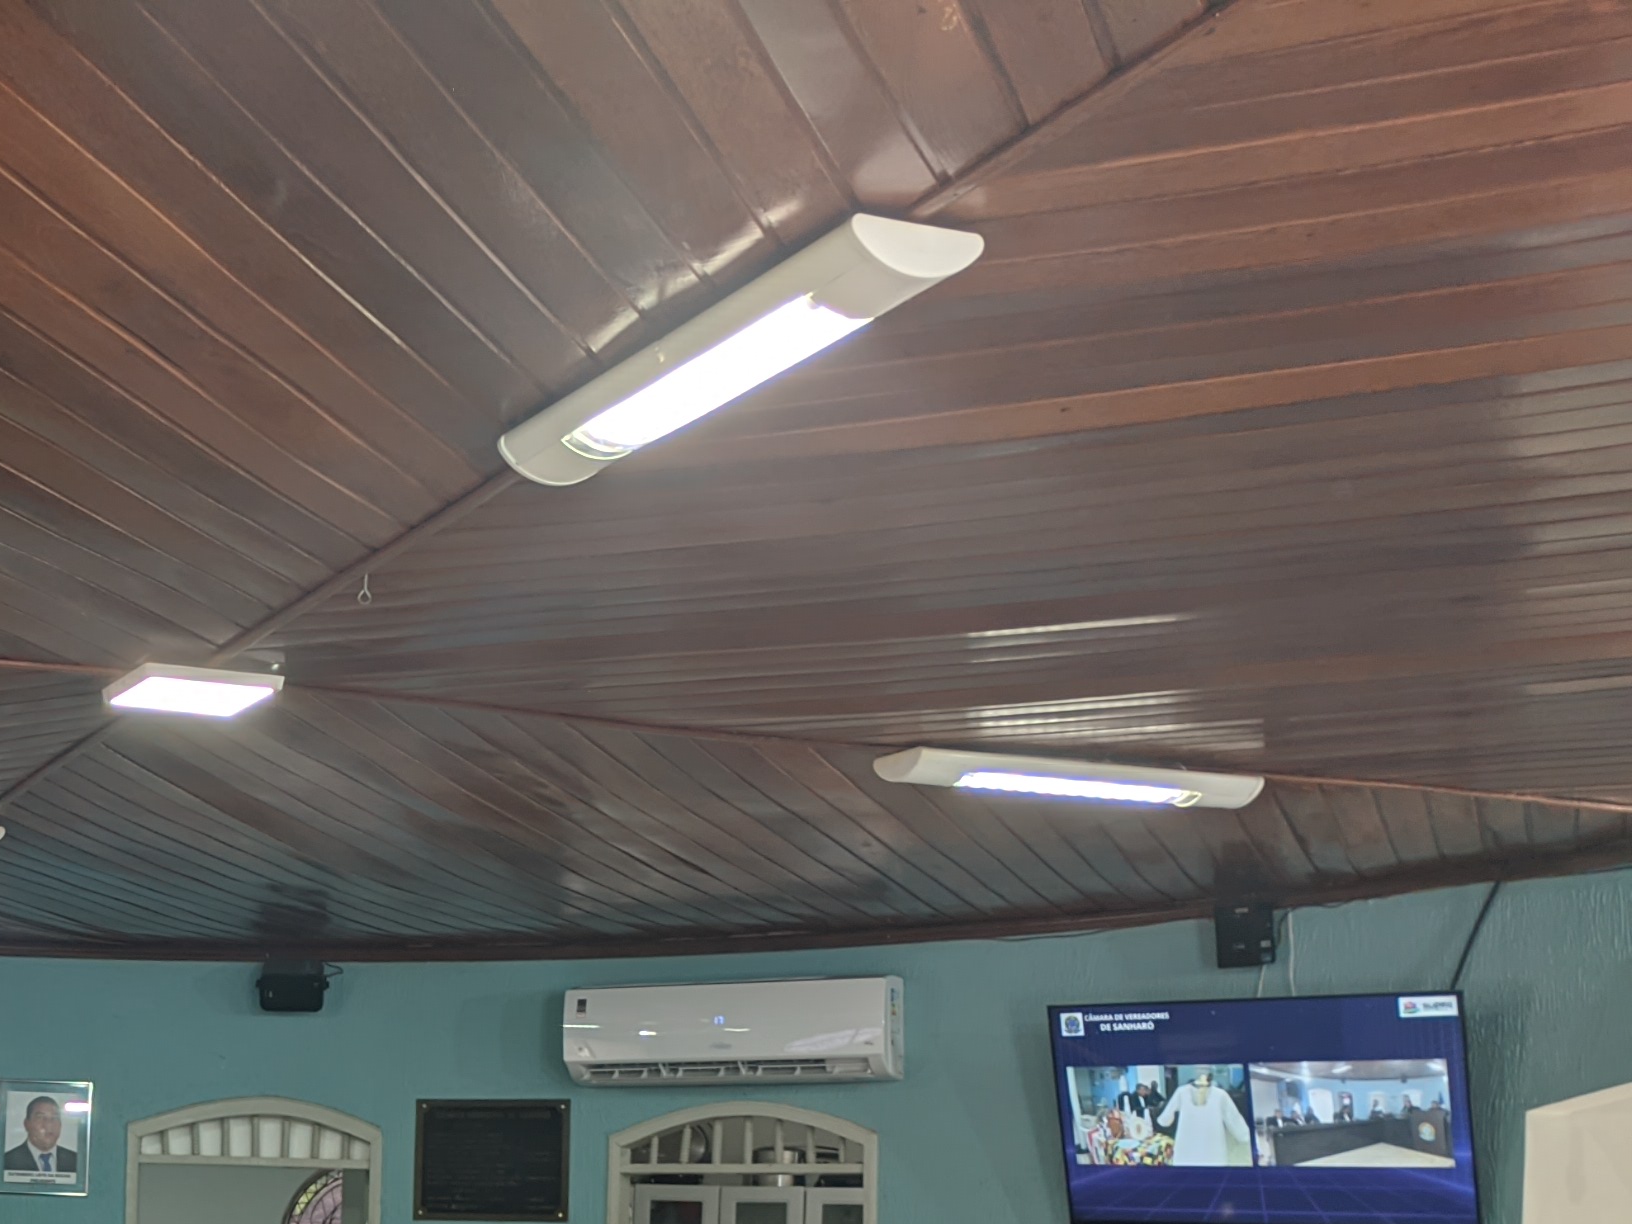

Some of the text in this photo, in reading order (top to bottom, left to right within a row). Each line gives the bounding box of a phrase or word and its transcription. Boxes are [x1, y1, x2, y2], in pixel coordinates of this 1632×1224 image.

[1084, 1011, 1170, 1022] CÂMARA DE VEREADORES
[1100, 1020, 1155, 1032] DE SANHARÓ
